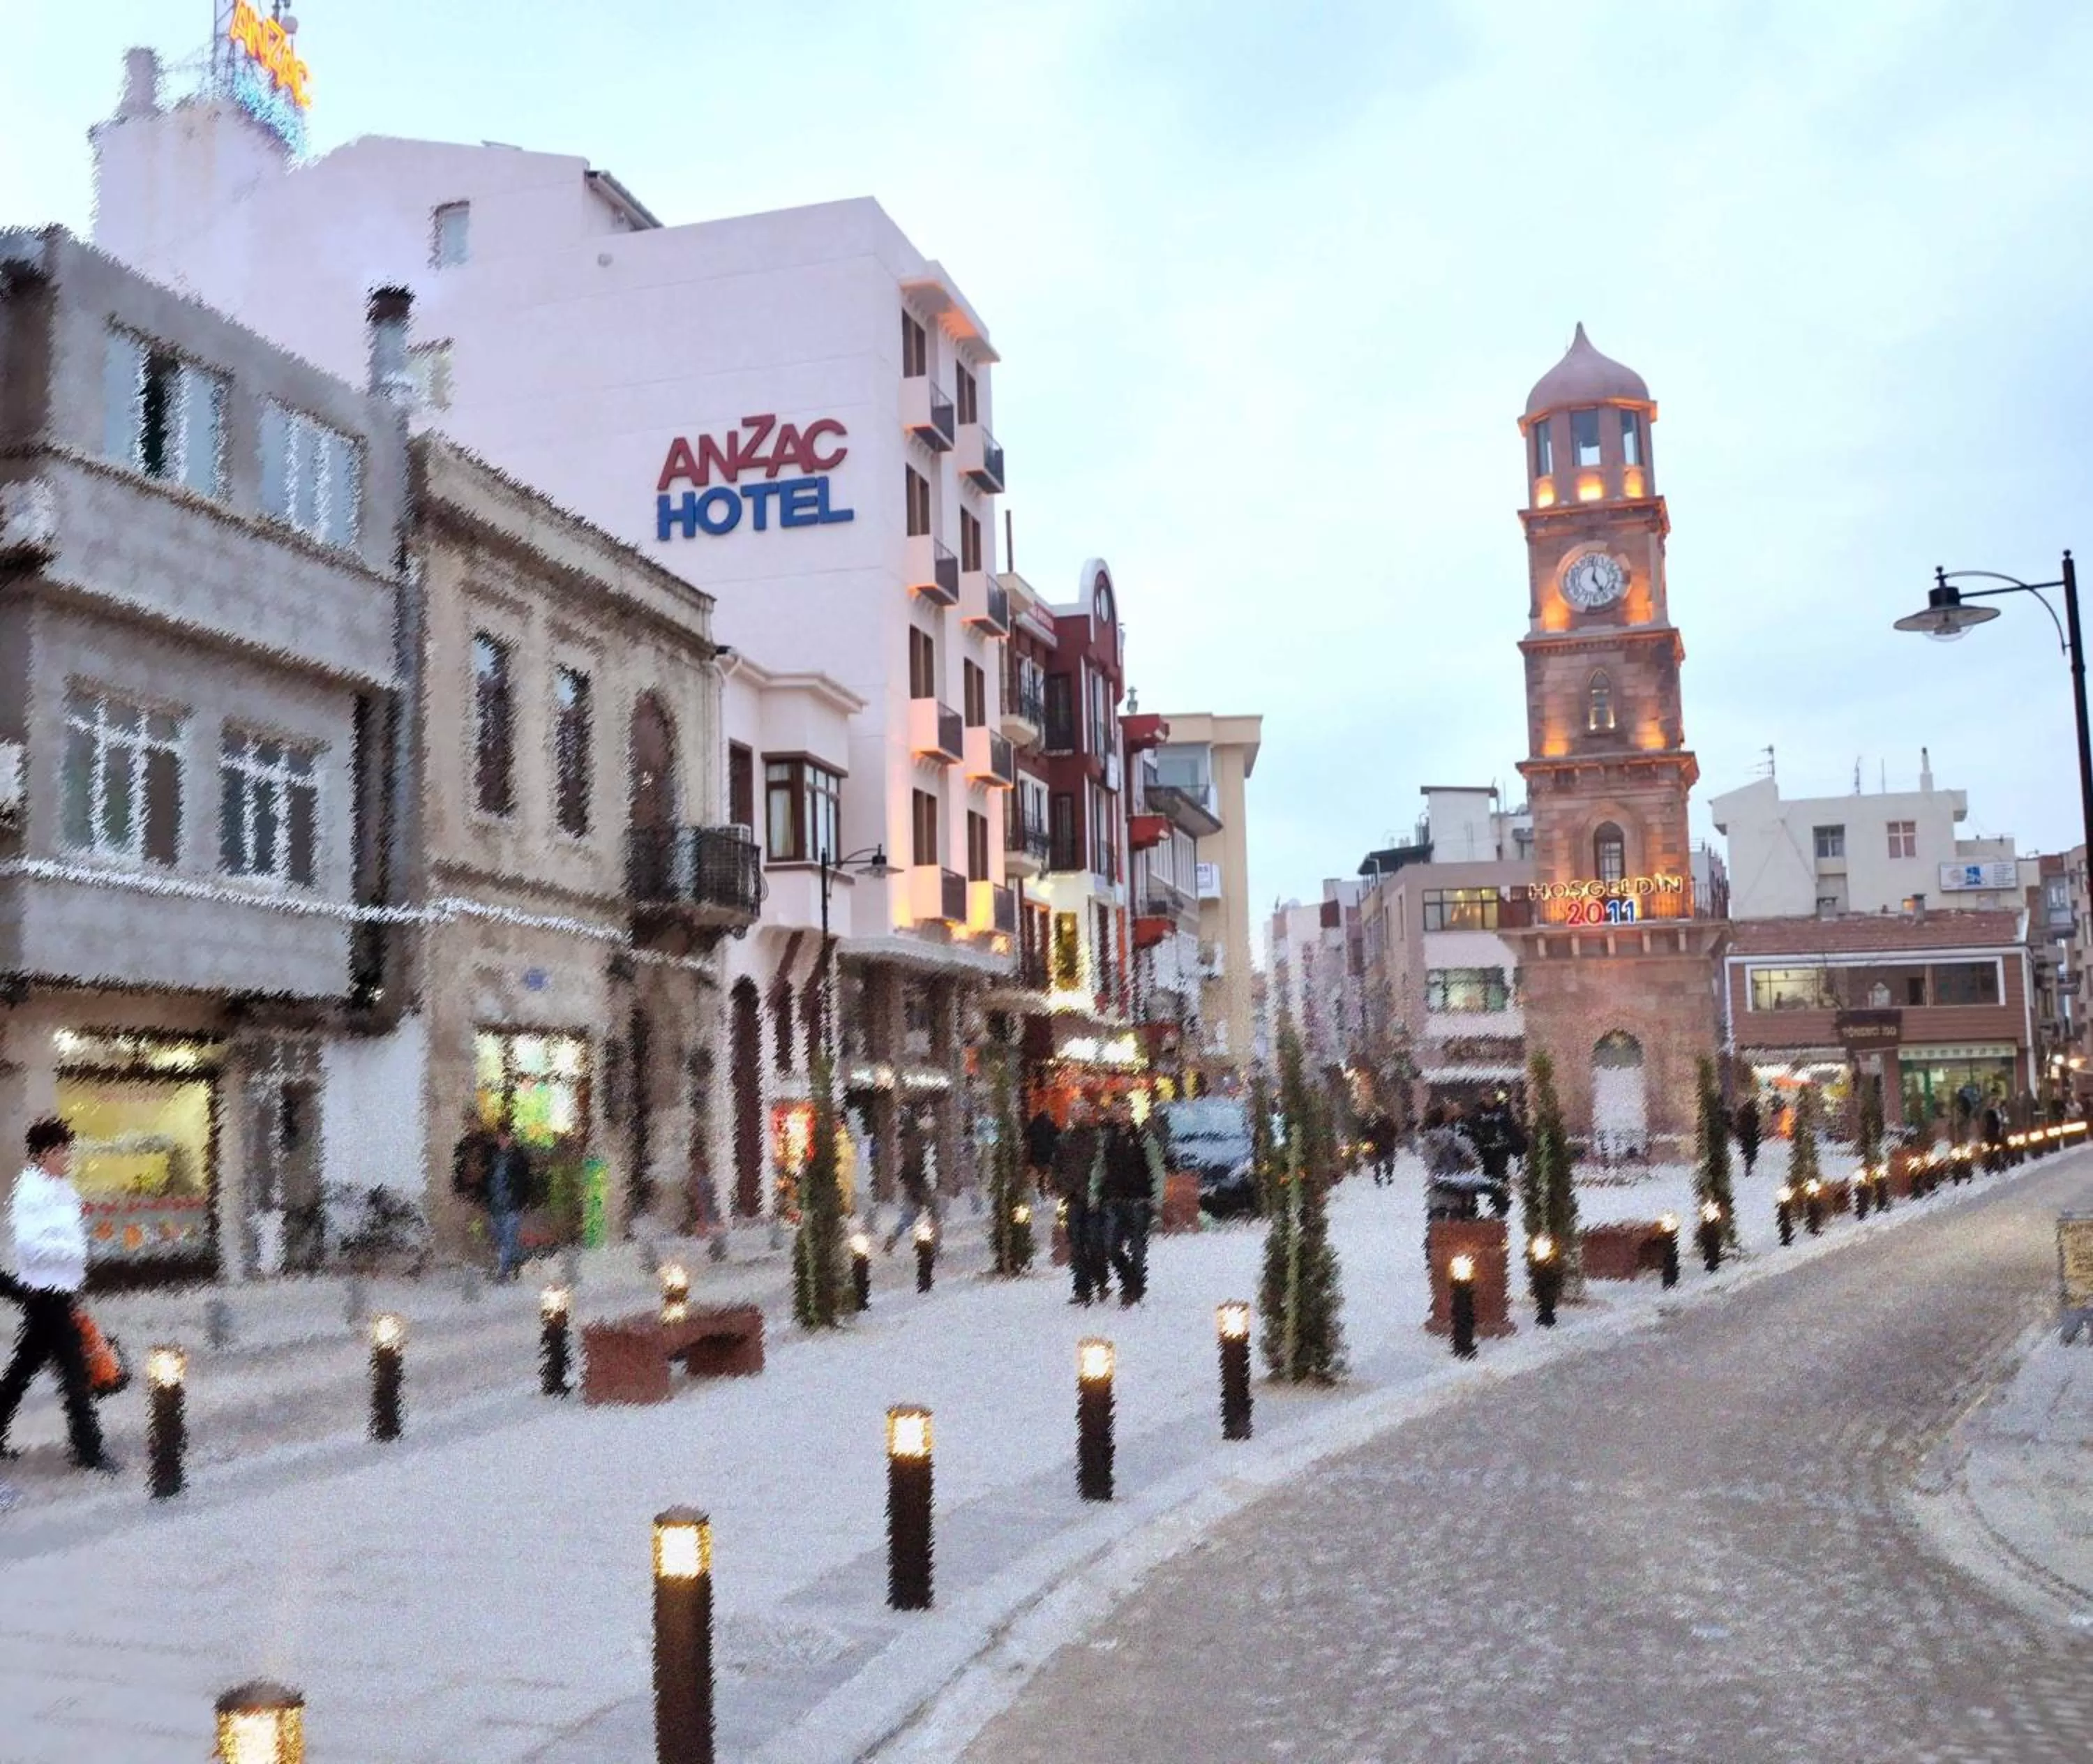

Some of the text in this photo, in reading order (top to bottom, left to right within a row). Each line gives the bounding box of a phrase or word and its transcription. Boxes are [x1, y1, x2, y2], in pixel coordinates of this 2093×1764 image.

[657, 413, 848, 491] ANZAC
[657, 475, 855, 541] HOTEL
[1567, 898, 1637, 927] 2011
